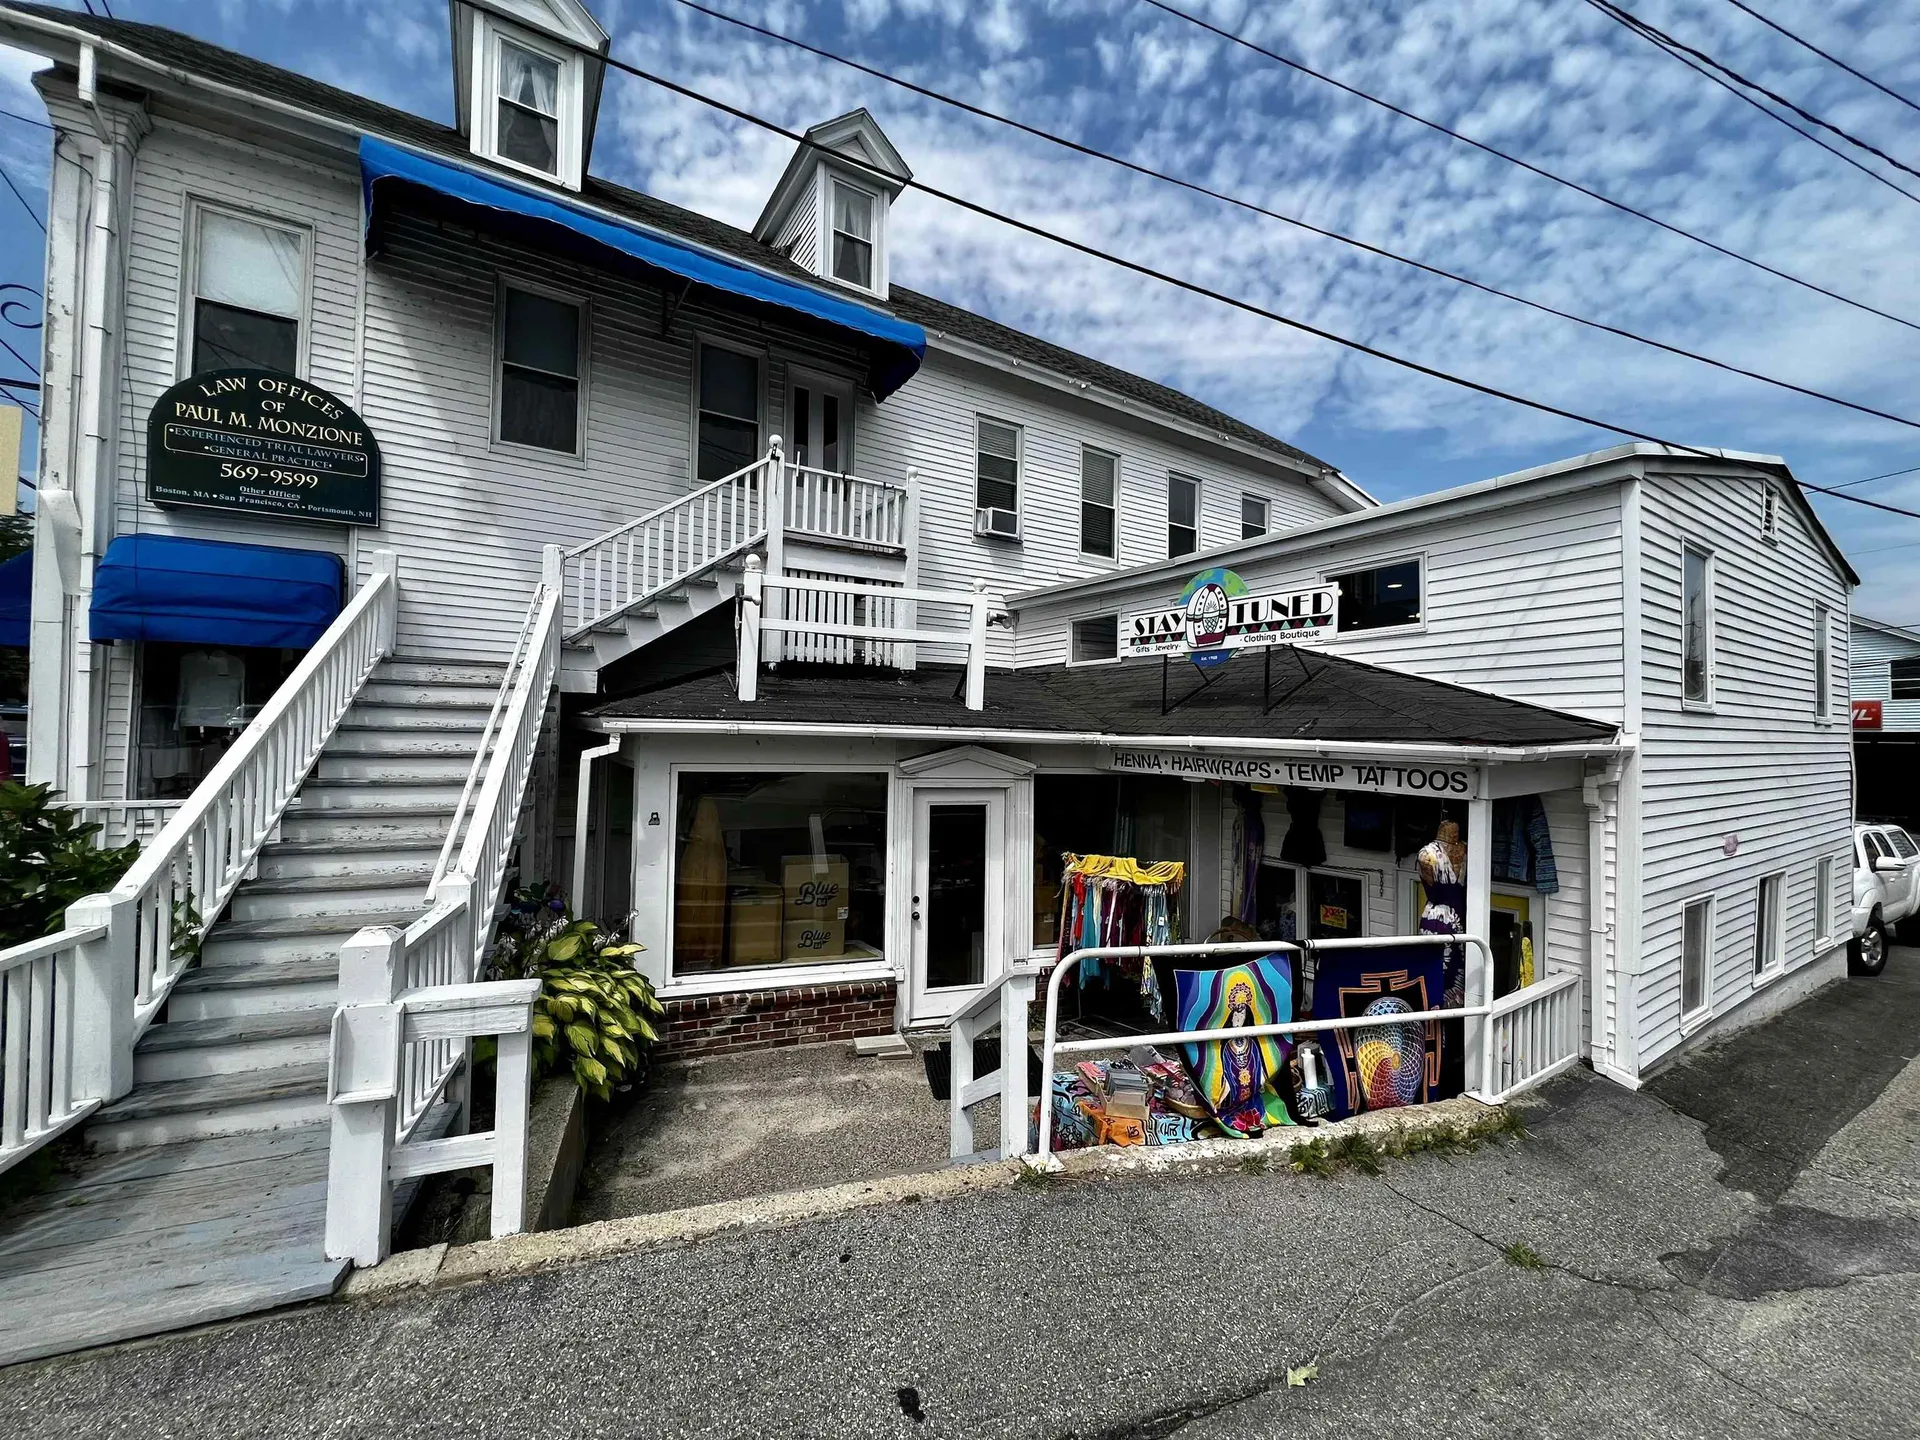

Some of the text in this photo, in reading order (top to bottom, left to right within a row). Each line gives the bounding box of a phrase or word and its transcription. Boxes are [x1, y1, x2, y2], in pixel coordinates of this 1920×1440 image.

[199, 377, 344, 420] LAW OFFICES
[261, 400, 286, 414] OF
[175, 402, 363, 446] PAUL M. MONZIONE
[174, 427, 360, 462] EXPERIENCED TRIAL LAWYERS
[209, 445, 330, 469] GENERAL PRACTICE
[220, 463, 319, 489] 569-9599
[155, 485, 372, 518] Boston, MA San Francisco, CA Portsmouth, NH
[239, 485, 301, 500] Other Offices
[1134, 591, 1334, 636] STAY TUNED
[1135, 628, 1320, 654] Gifts Jewelry Clothing Boutique
[1113, 752, 1469, 793] HENNA HAIRWRAPS TEMP TATTOOS
[794, 881, 840, 906] Blue
[797, 929, 832, 948] Blue
